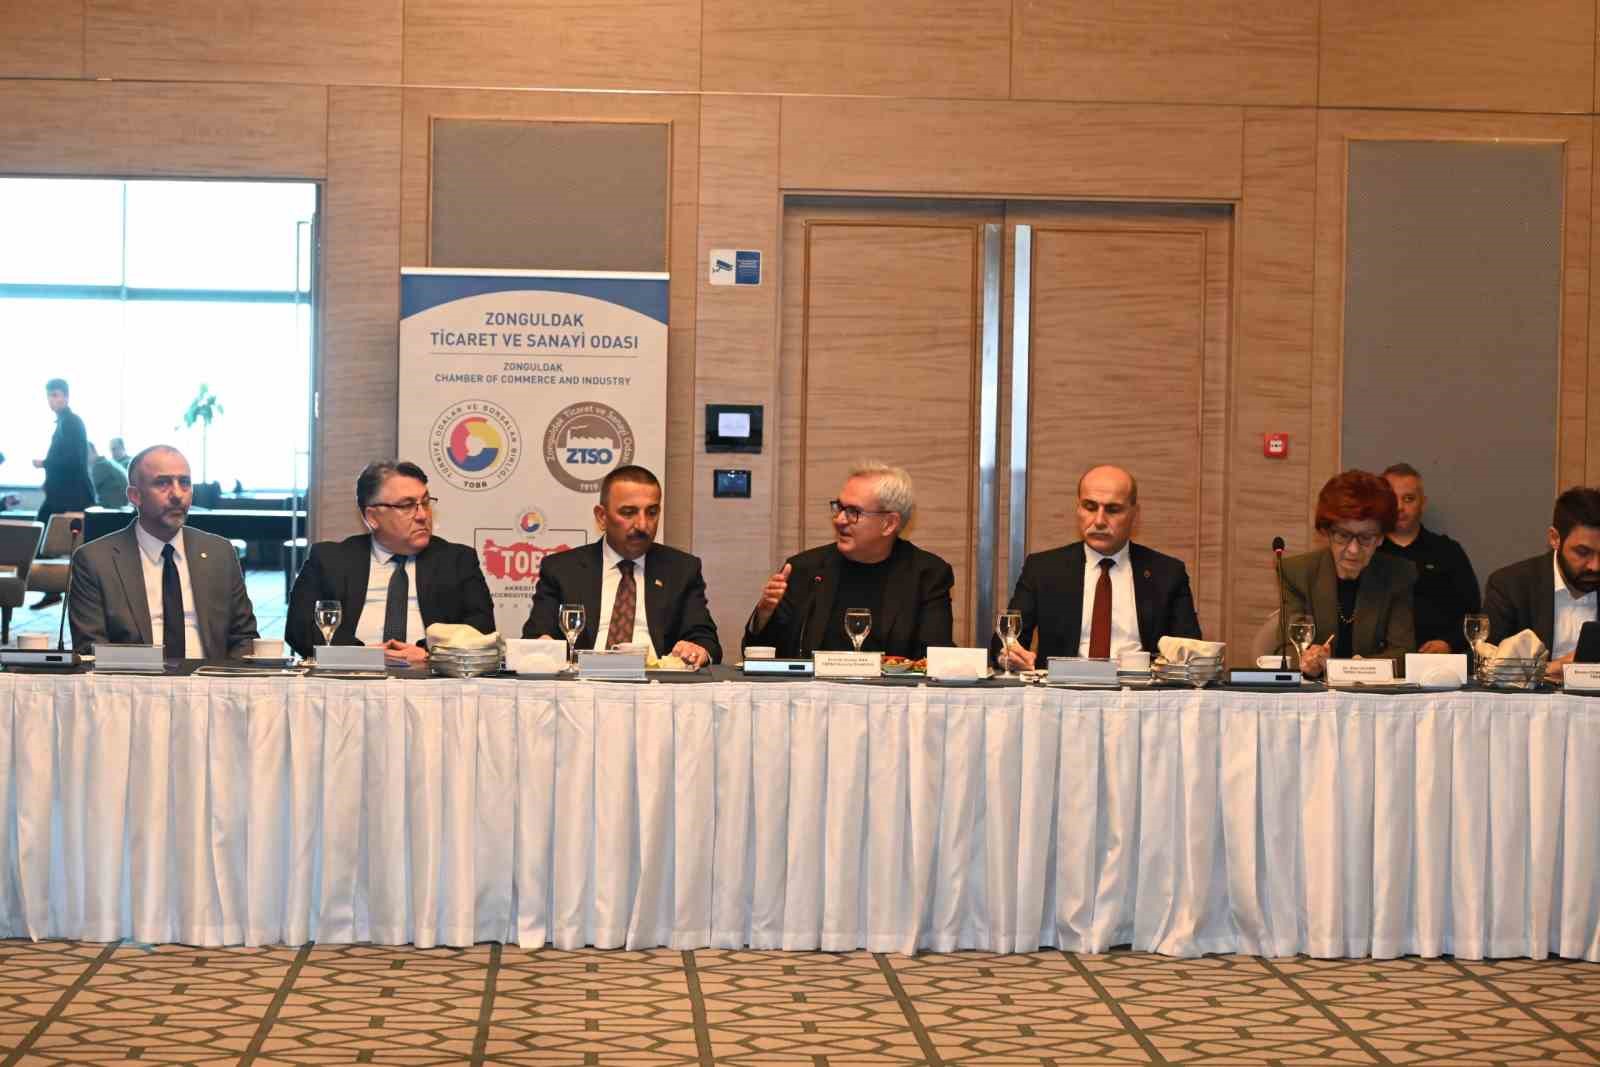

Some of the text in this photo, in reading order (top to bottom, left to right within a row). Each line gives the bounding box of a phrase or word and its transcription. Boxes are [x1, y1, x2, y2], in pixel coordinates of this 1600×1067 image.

[485, 312, 584, 327] ZONGULDAK
[430, 329, 638, 349] TİCARET VE SANAYİ ODASI
[504, 362, 563, 372] ZONGULDAK
[435, 374, 632, 386] CHAMBER OF COMMERCE AND INDUSTRY
[566, 447, 613, 464] ZTSO
[501, 550, 543, 575] TOB
